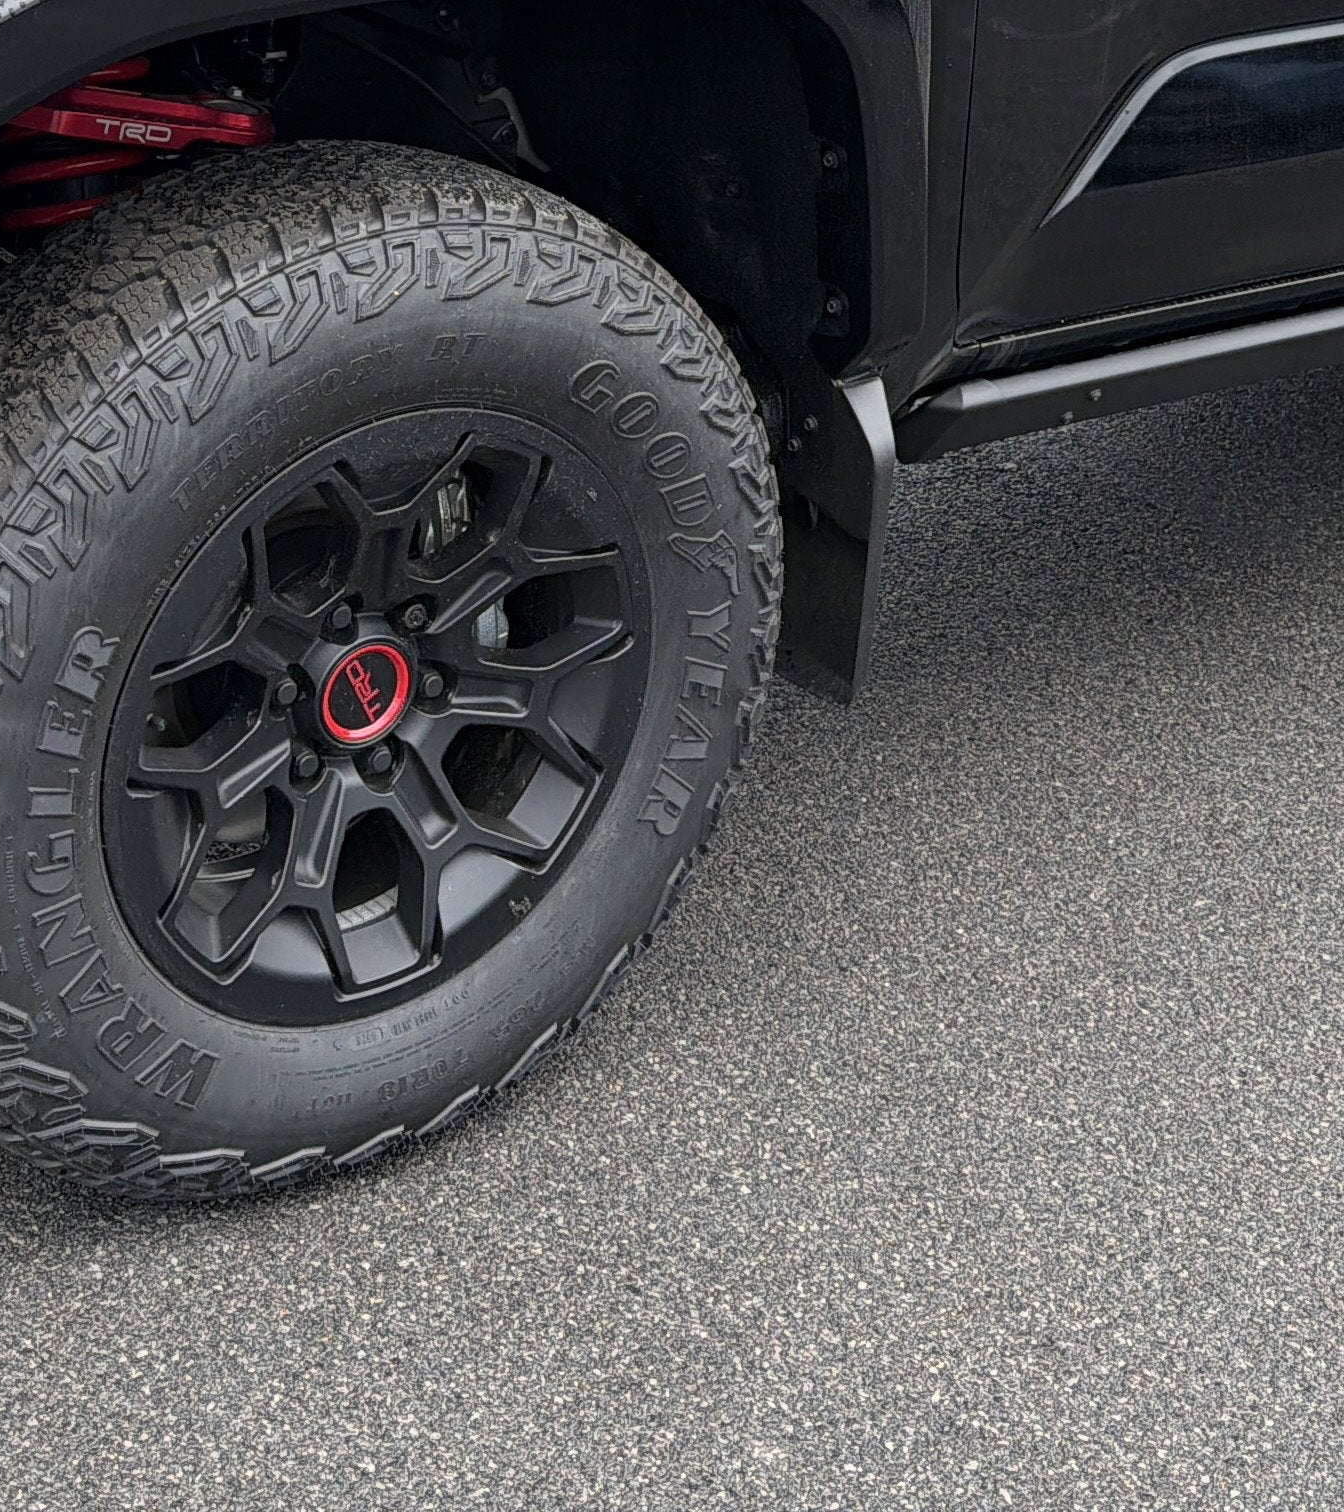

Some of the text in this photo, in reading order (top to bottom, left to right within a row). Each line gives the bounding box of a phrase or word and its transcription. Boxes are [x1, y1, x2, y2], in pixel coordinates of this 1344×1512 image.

[96, 118, 172, 144] TRD
[168, 343, 403, 512] TERRITORY
[345, 659, 382, 723] TRD
[25, 624, 221, 1111] WRANGLER
